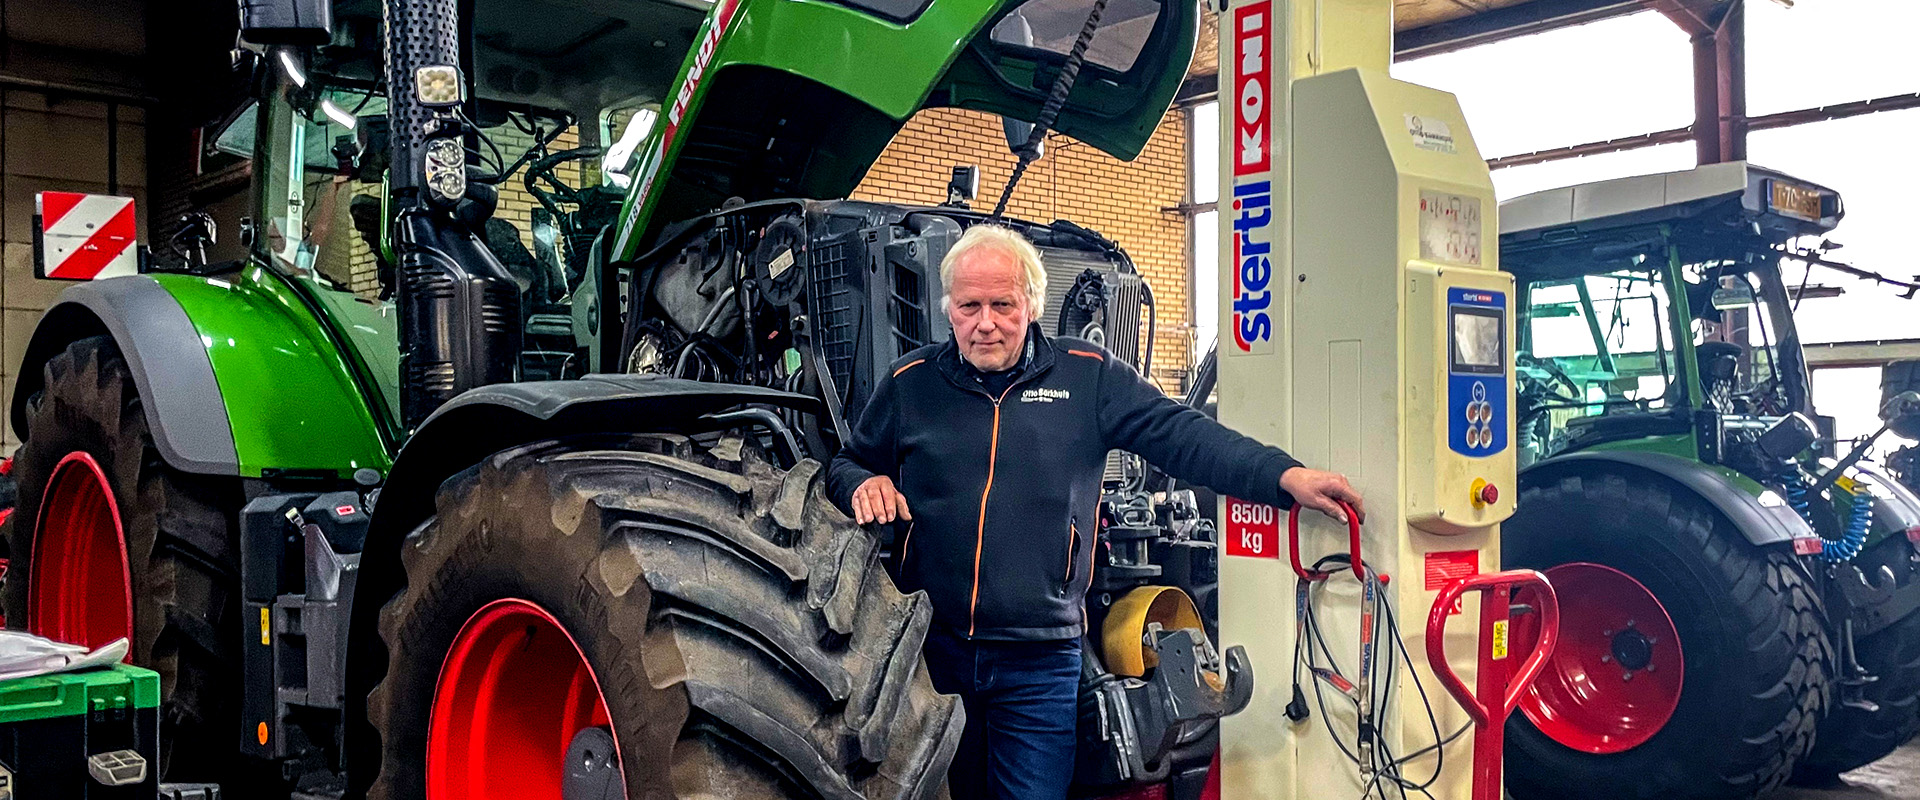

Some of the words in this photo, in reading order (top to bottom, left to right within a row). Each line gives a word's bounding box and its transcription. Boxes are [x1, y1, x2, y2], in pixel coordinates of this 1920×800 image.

[668, 10, 722, 127] FENDT
[1241, 12, 1263, 166] KONI
[625, 204, 640, 235] 718
[1233, 181, 1271, 347] stertil
[1231, 503, 1273, 526] 8500
[1241, 527, 1263, 554] kg
